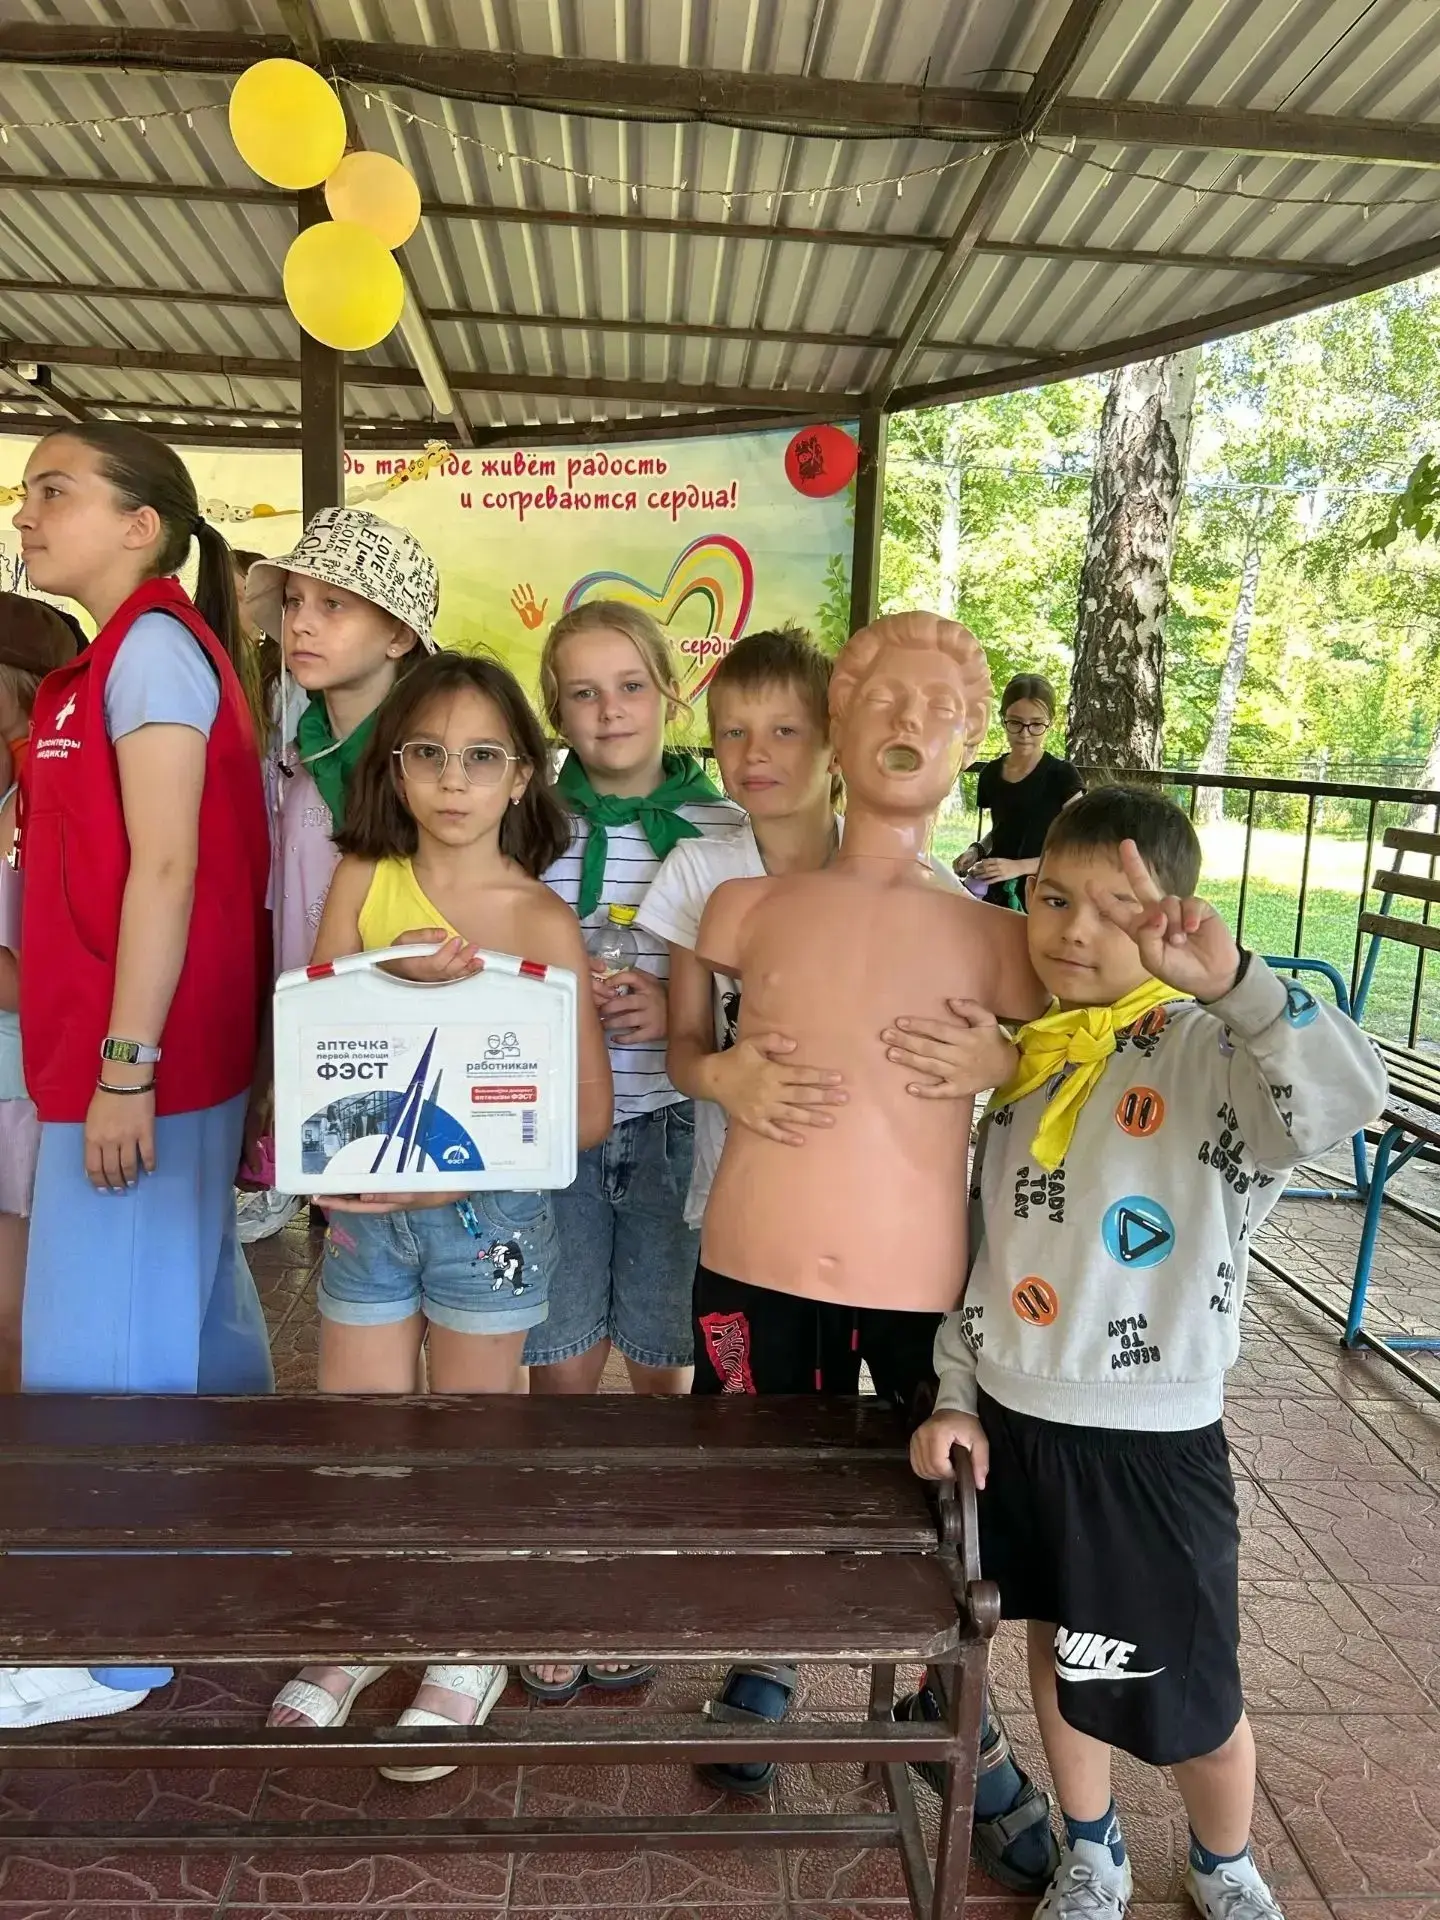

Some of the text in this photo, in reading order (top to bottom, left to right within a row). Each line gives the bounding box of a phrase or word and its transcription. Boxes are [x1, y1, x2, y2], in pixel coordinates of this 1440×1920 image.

[482, 451, 555, 476] живёт
[567, 451, 668, 489] радость
[460, 481, 737, 522] и согреваются сердца!
[316, 1040, 389, 1051] аптечка
[316, 1062, 389, 1080] ФЭСТ
[466, 1061, 538, 1072] работникам
[1014, 1166, 1030, 1219] PLAY
[1030, 1173, 1047, 1205] TO
[1048, 1157, 1065, 1223] EADY
[1108, 1313, 1148, 1338] PLAY
[1120, 1331, 1145, 1350] TO
[1111, 1345, 1161, 1370] READY
[1054, 1626, 1137, 1673] NIKE
